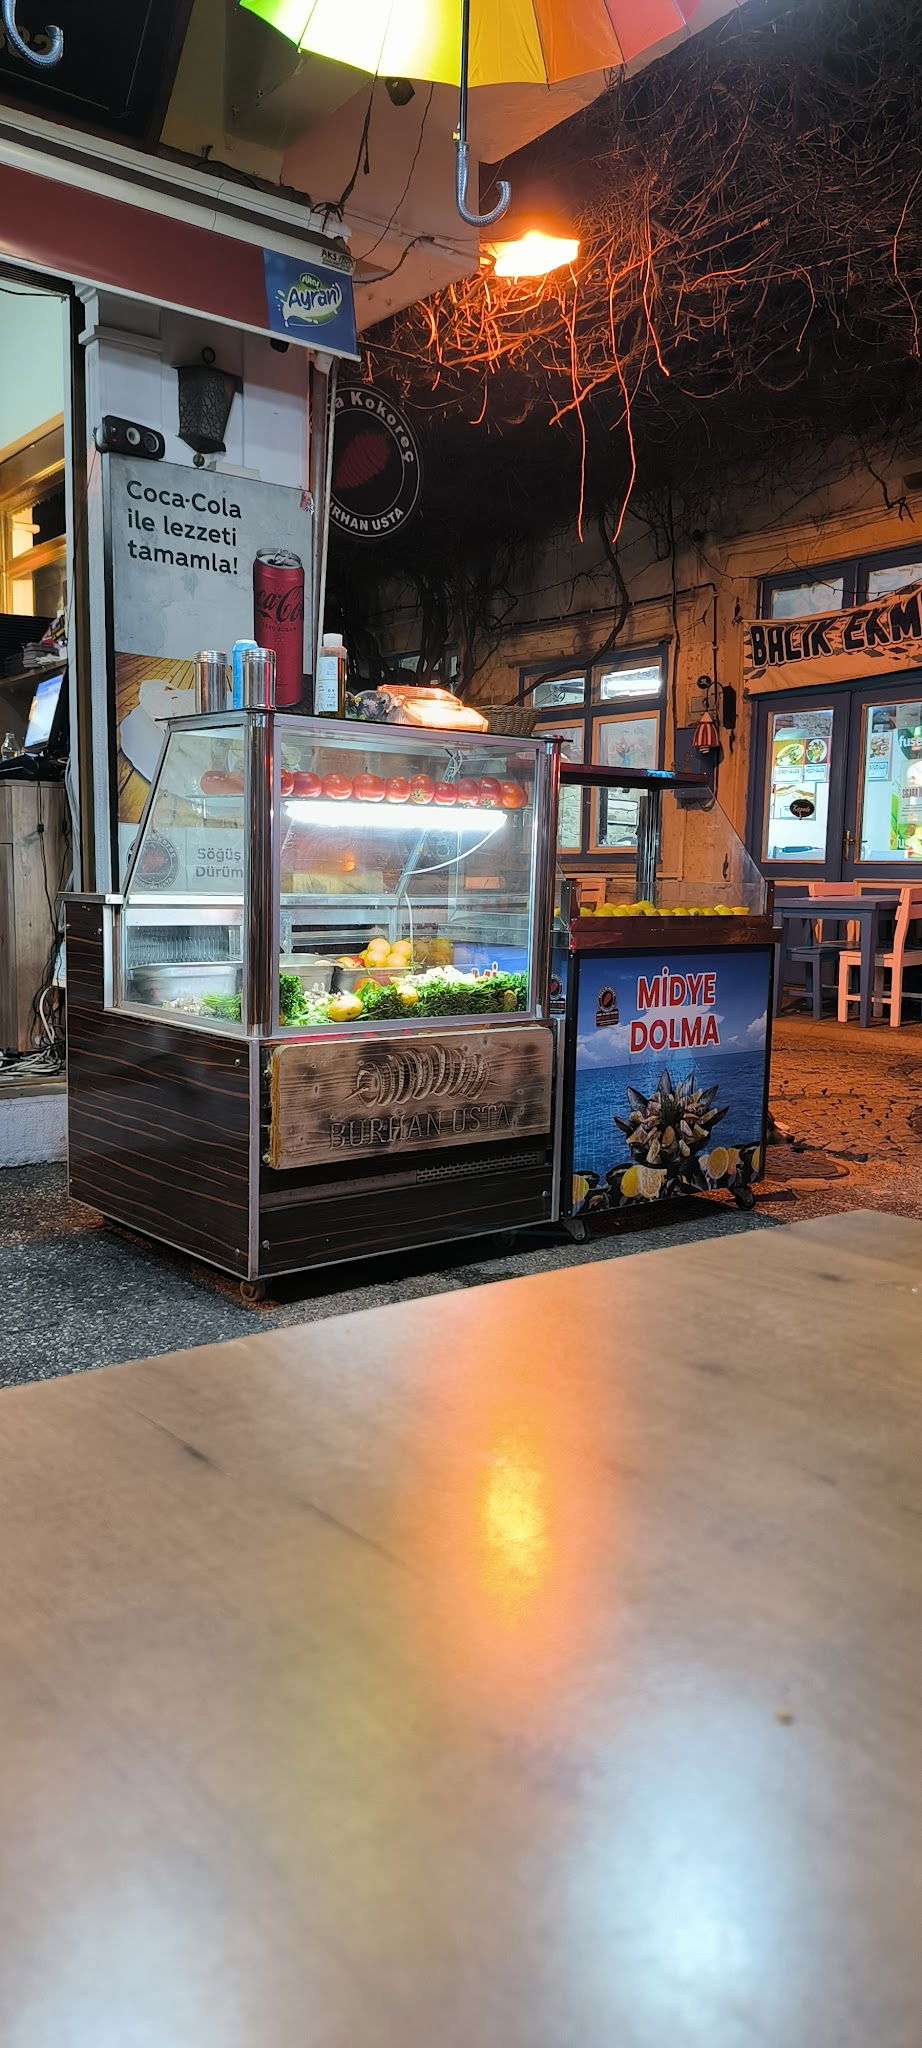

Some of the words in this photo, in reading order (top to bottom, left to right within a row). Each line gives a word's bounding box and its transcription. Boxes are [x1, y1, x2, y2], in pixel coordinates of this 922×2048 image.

[288, 286, 341, 311] Ayran
[350, 391, 414, 464] Kokoreç
[127, 508, 155, 532] ile
[163, 515, 237, 546] lezzeti
[372, 507, 404, 531] USTA
[127, 539, 238, 575] tamamla!
[749, 617, 839, 669] BALIK
[842, 592, 922, 653] EKM
[195, 866, 244, 878] Dürüm
[197, 847, 242, 863] Söğüş
[637, 966, 716, 1010] MİDYE
[630, 1014, 720, 1054] DOLMA
[329, 1111, 441, 1150] BURHAN
[452, 1103, 511, 1133] USTA
